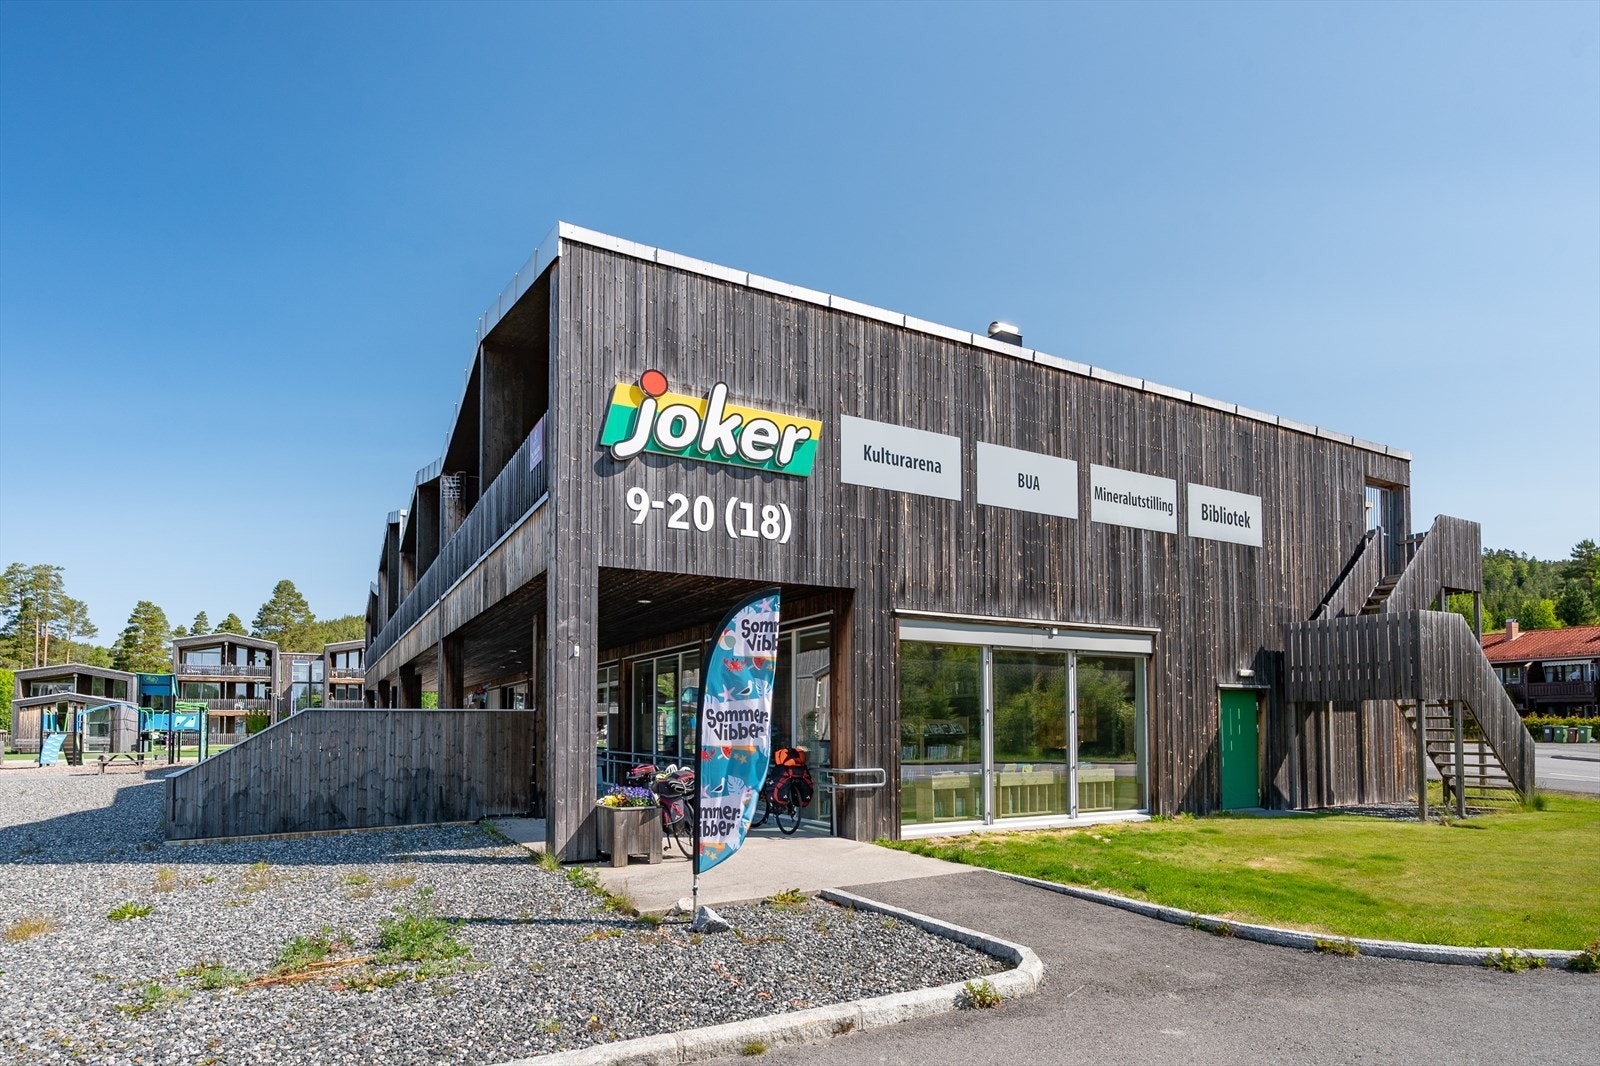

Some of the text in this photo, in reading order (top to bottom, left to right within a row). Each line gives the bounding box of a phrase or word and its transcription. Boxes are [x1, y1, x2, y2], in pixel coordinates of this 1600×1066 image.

[611, 369, 812, 467] joker
[864, 444, 942, 474] Kulturarena
[1017, 472, 1041, 491] BUA
[626, 486, 792, 544] 9-20 (18)
[1094, 486, 1174, 517] Mineralutstilling
[1201, 503, 1251, 529] Bibliotek
[713, 722, 764, 741] Vibber
